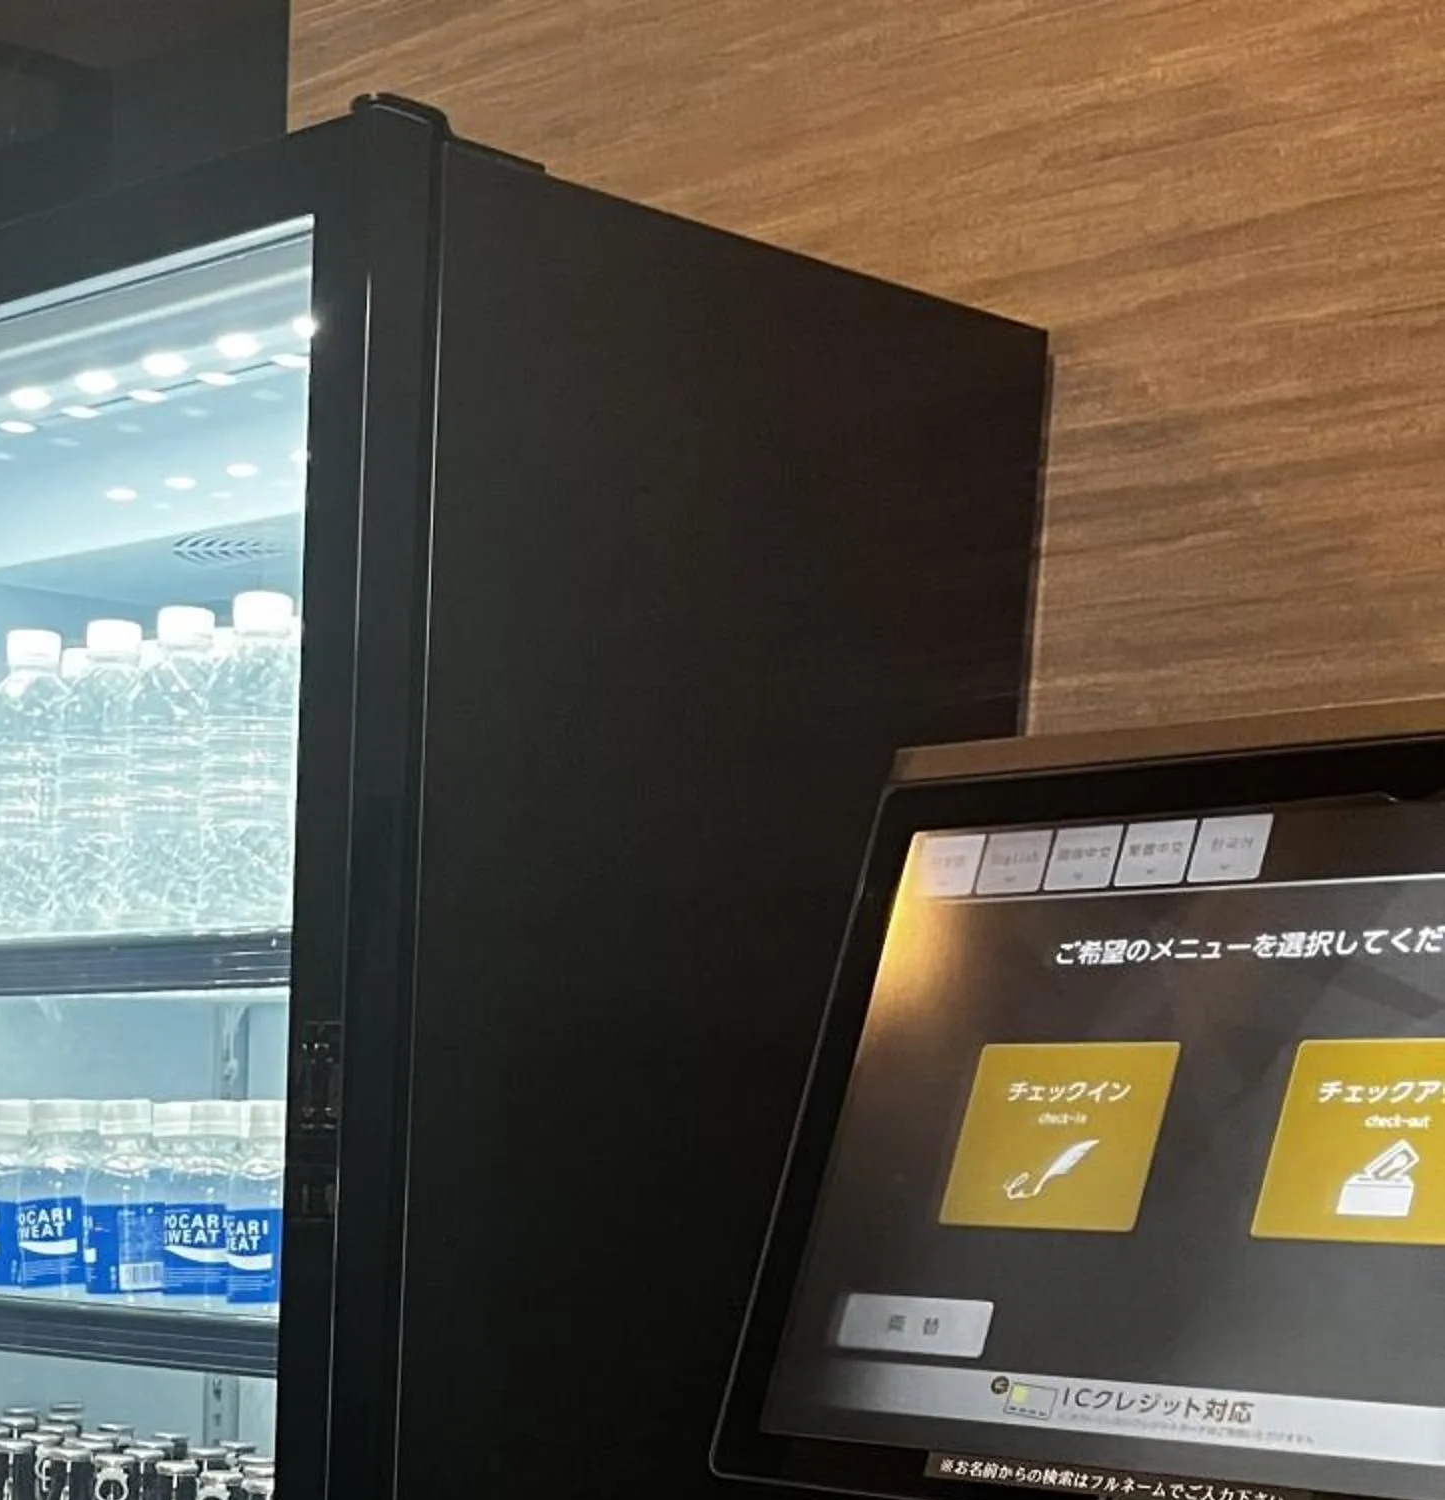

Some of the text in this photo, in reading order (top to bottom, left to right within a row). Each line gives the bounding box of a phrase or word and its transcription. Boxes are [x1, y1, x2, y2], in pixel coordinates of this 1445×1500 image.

[1007, 1081, 1132, 1103] チェックイン
[1318, 1080, 1445, 1104] チェックア
